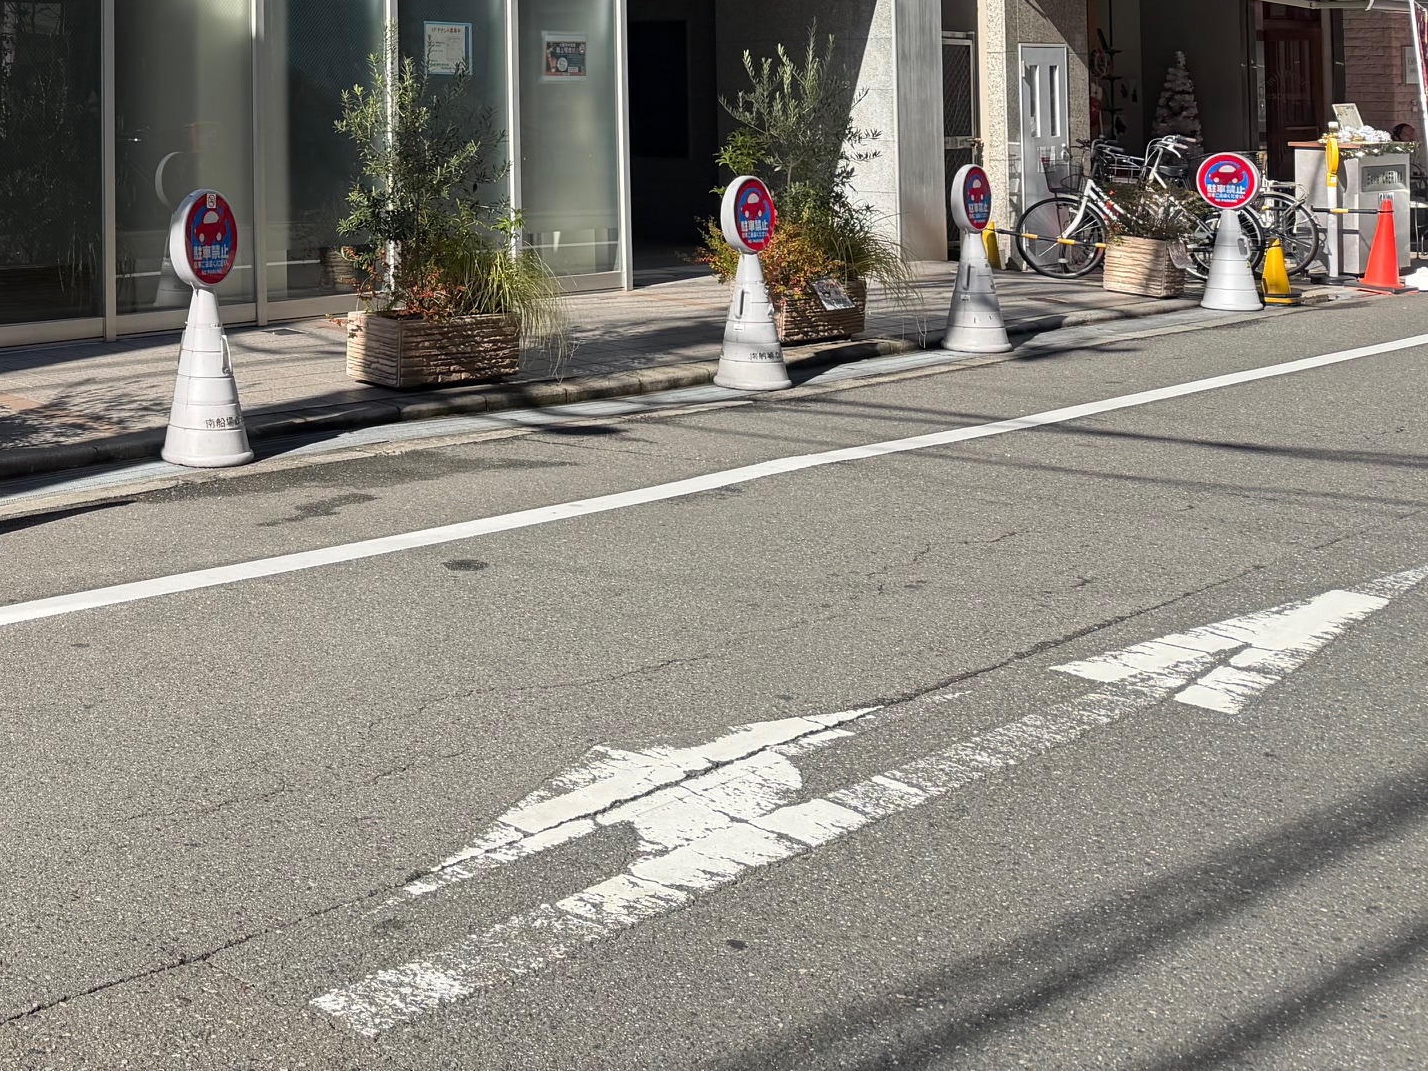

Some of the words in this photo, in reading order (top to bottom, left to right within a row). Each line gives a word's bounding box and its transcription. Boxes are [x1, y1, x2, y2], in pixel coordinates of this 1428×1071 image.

[1207, 184, 1246, 195] 駐車禁止
[741, 219, 769, 232] 駐車禁止
[193, 244, 229, 260] 駐車禁止
